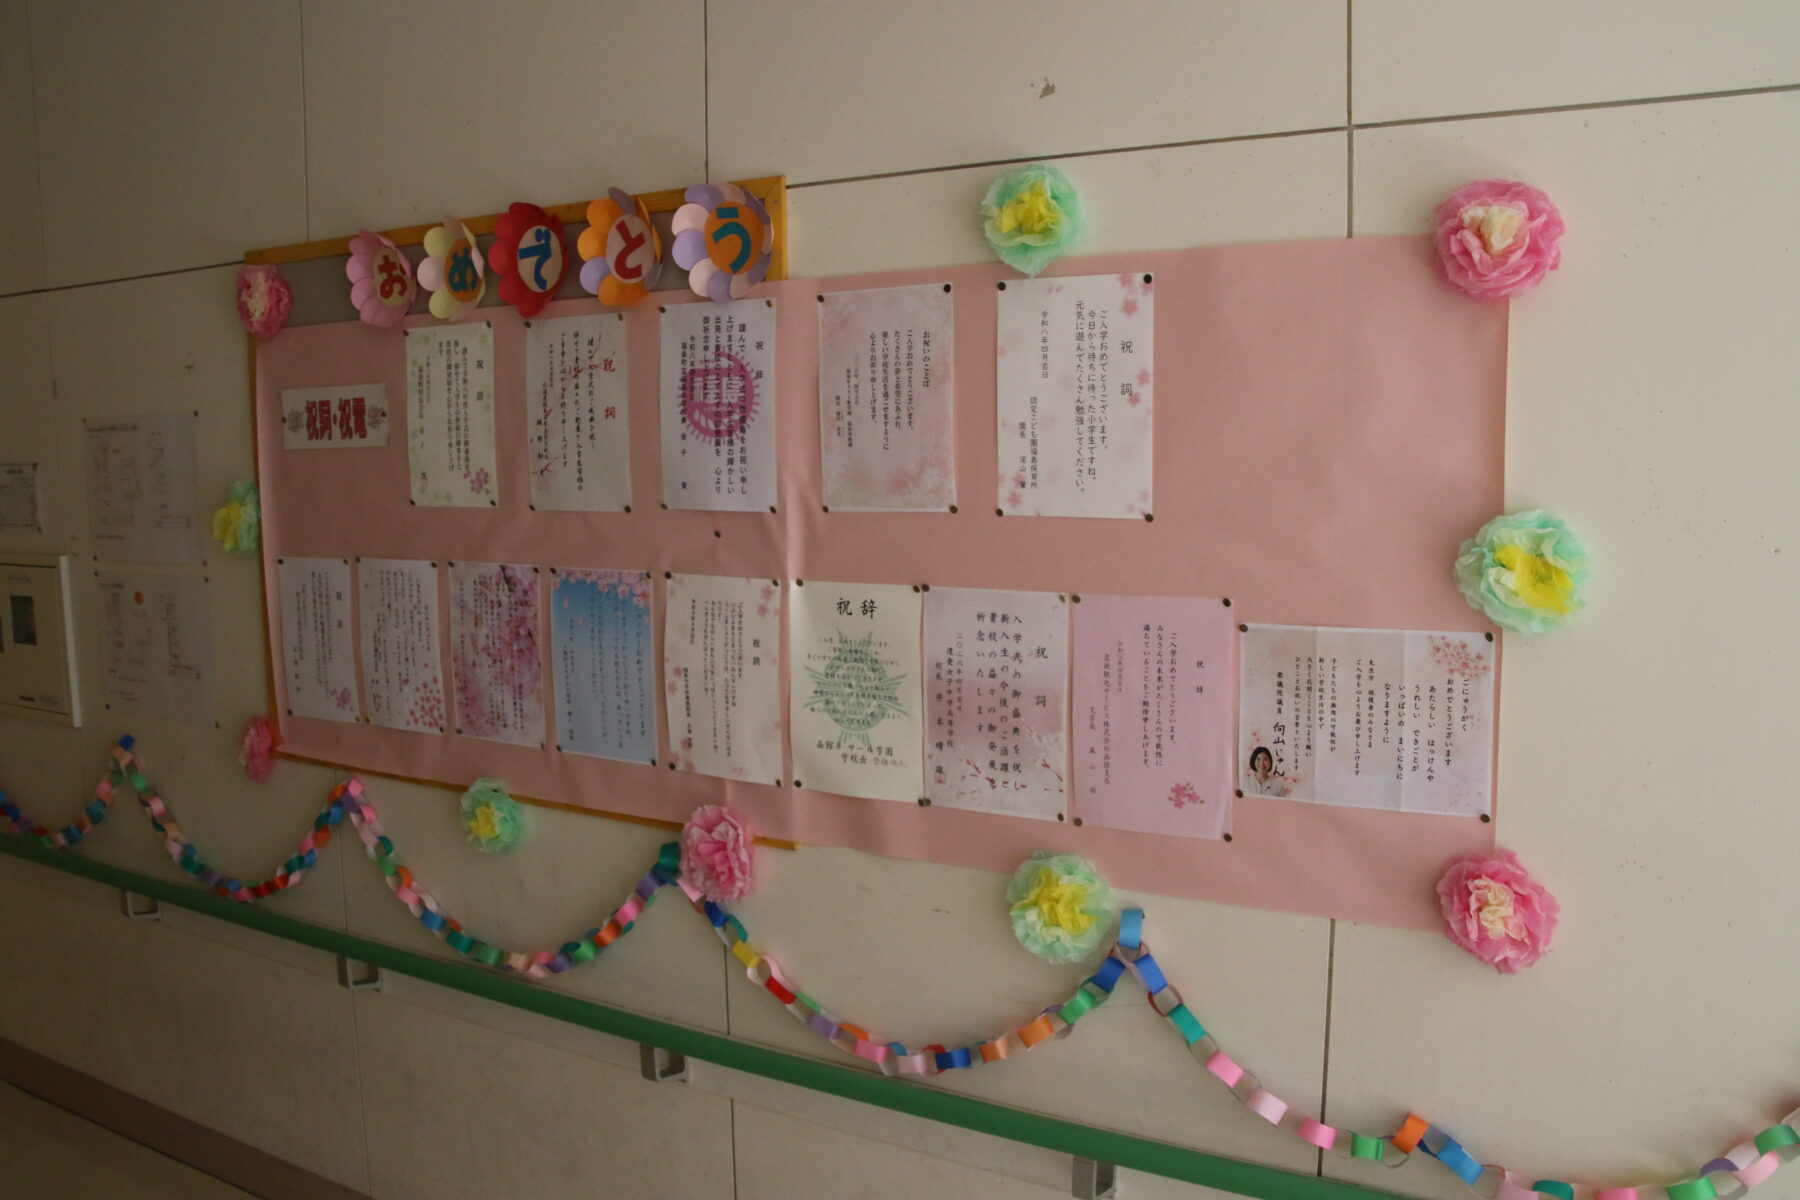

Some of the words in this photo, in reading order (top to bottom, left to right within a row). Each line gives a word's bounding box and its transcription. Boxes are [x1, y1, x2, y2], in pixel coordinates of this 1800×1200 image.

[1087, 310, 1097, 480] 今日から待ちに待った小学生ですね。
[1099, 310, 1109, 451] ご入学おめでとうございます。
[836, 598, 877, 619] 祝辞
[976, 611, 986, 733] 祈念いたします
[1169, 632, 1177, 744] ご入学おめでとうございます。
[1383, 682, 1391, 744] なりますように
[1398, 684, 1406, 727] いっぱいの
[1413, 684, 1421, 718] うれしい
[1428, 685, 1436, 729] あたらしい
[1444, 678, 1454, 766] おめでとうございます
[1461, 678, 1470, 731] ごにゅうがく
[1272, 721, 1286, 777] 向山じゅん
[1396, 737, 1405, 780] まいにちに
[1412, 729, 1420, 772] できごとが
[1426, 739, 1434, 782] はっけんや
